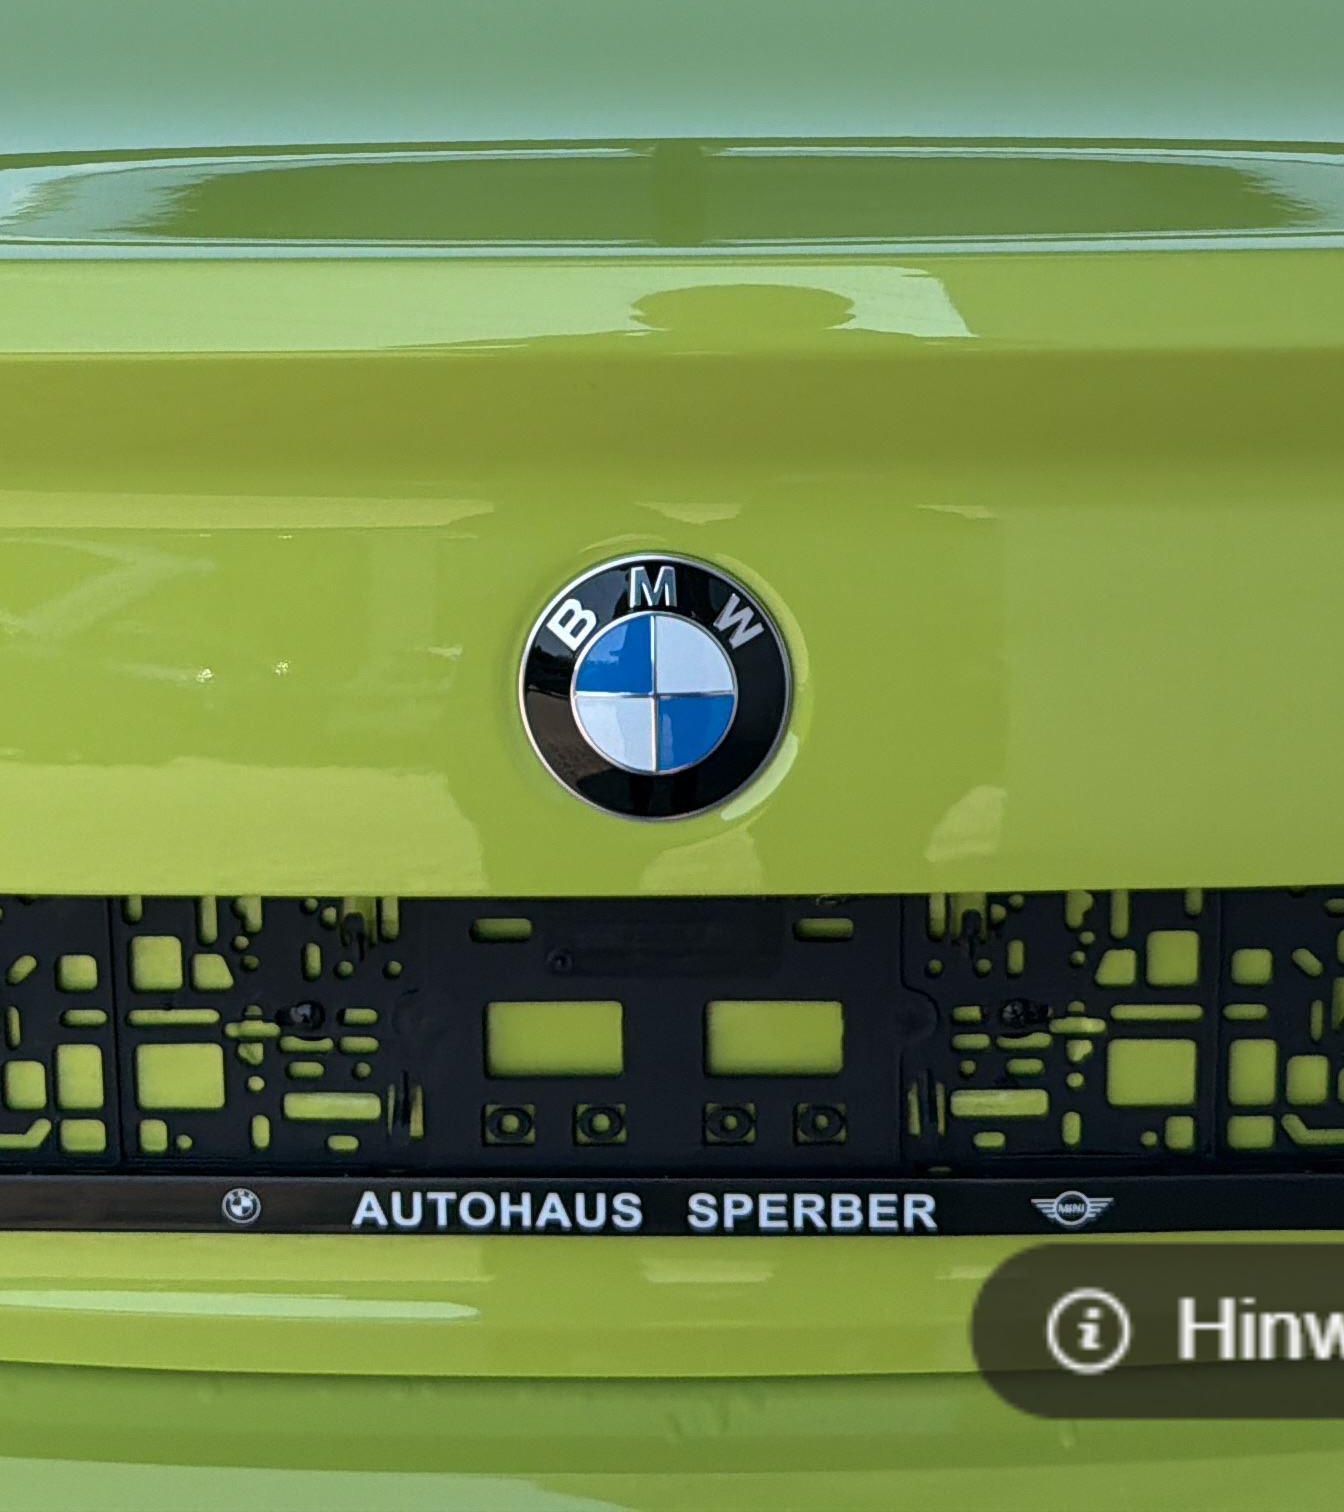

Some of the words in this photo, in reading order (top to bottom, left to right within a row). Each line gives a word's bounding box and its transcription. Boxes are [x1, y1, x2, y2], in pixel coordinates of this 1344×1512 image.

[546, 565, 764, 652] BMW
[352, 1190, 644, 1230] AUTOHAUS
[687, 1192, 939, 1233] SPERBER
